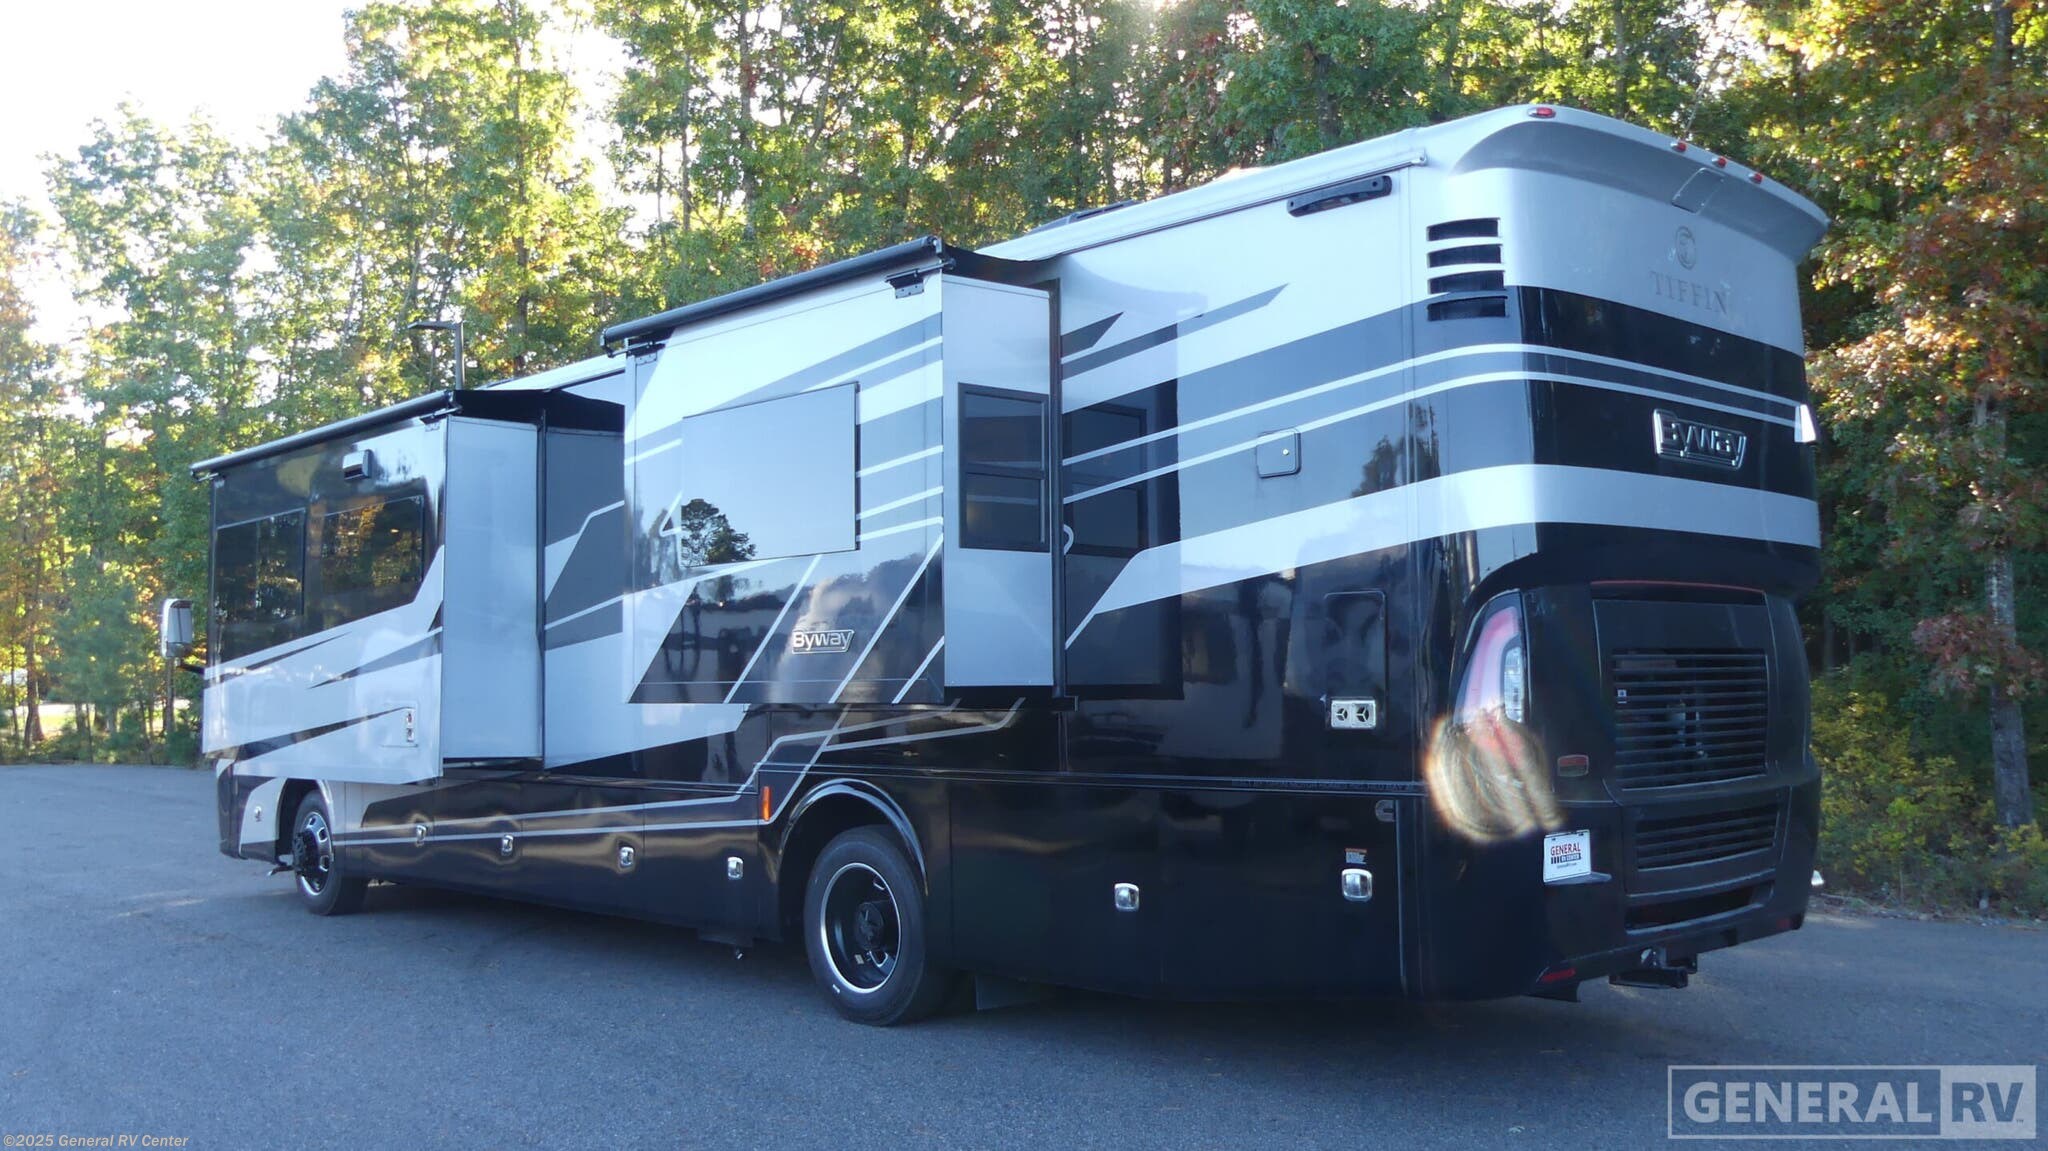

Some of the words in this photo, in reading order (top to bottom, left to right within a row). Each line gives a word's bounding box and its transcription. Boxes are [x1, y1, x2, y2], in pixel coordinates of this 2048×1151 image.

[1650, 270, 1729, 316] TIFFIN
[792, 630, 852, 651] Byway
[1550, 842, 1582, 856] GENERAL
